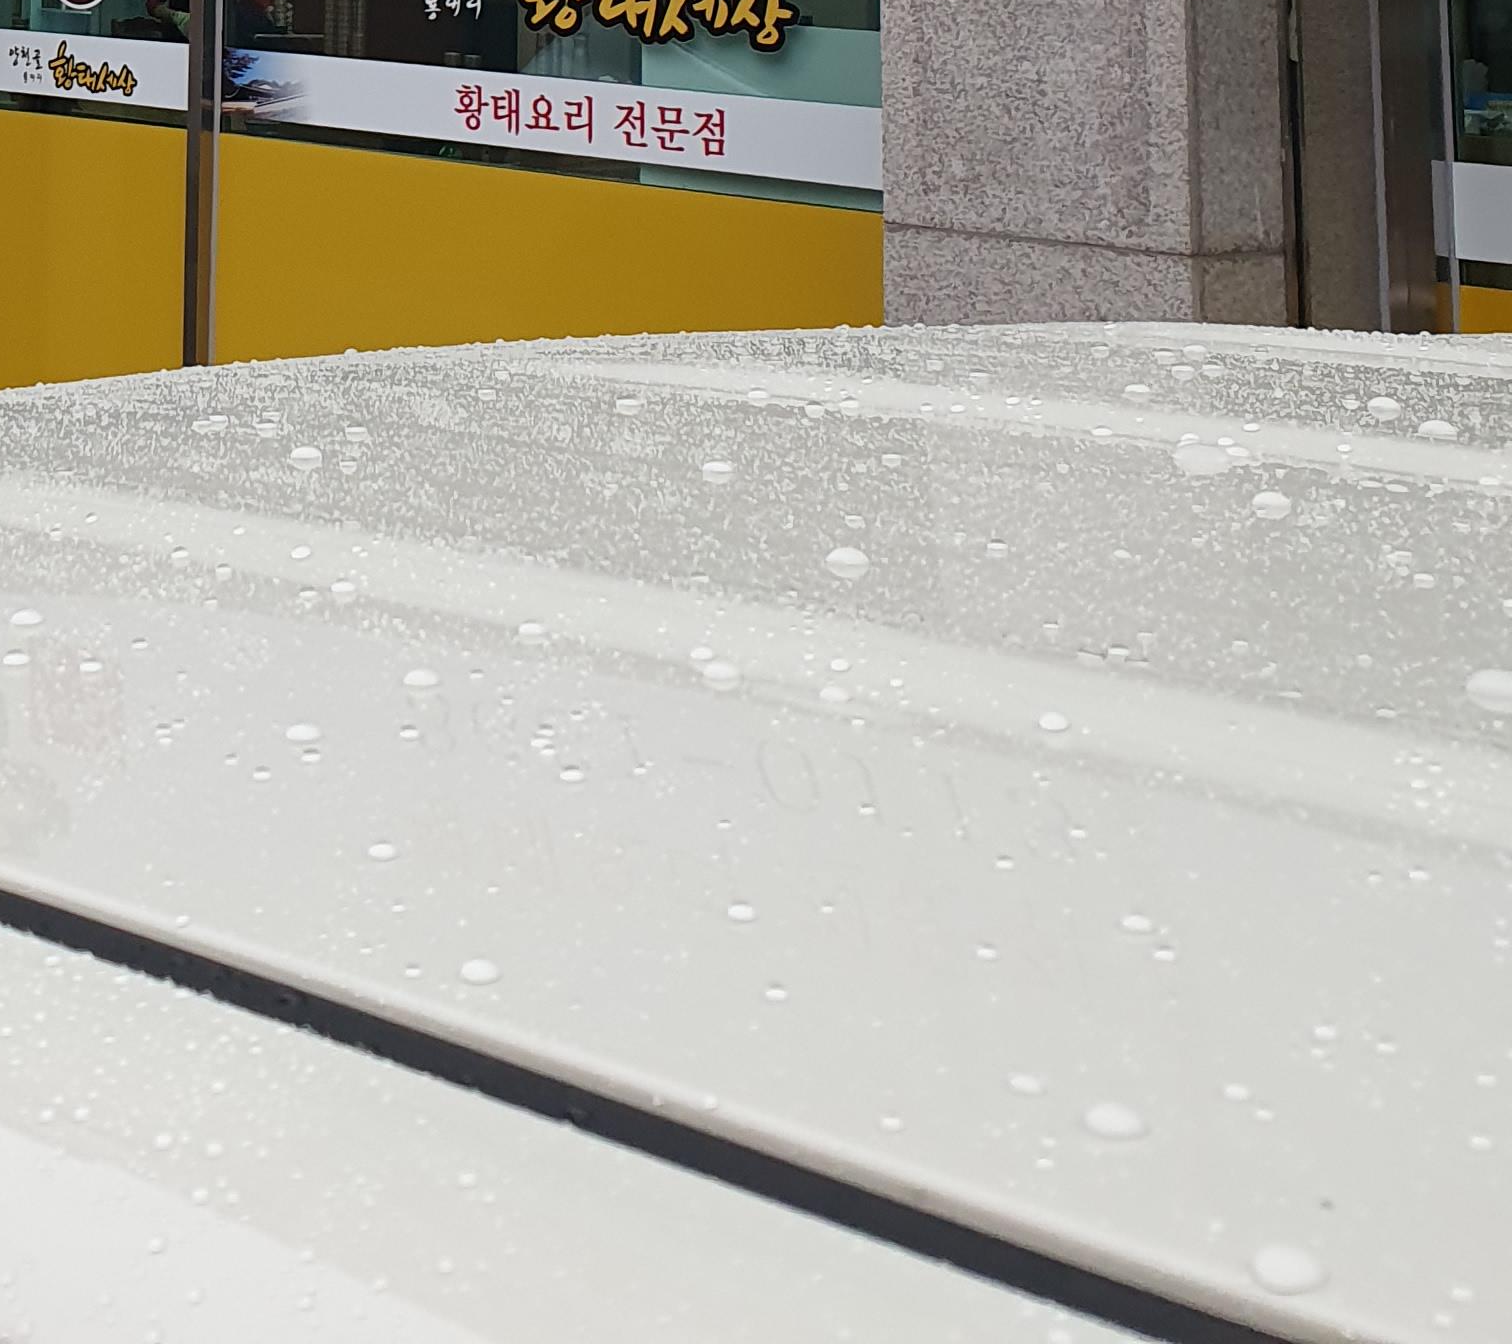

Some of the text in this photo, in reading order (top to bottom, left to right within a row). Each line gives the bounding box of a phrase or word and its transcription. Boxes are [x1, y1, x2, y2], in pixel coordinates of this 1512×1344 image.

[48, 39, 138, 97] 황태세상
[454, 82, 729, 158] 황태요리 전문점
